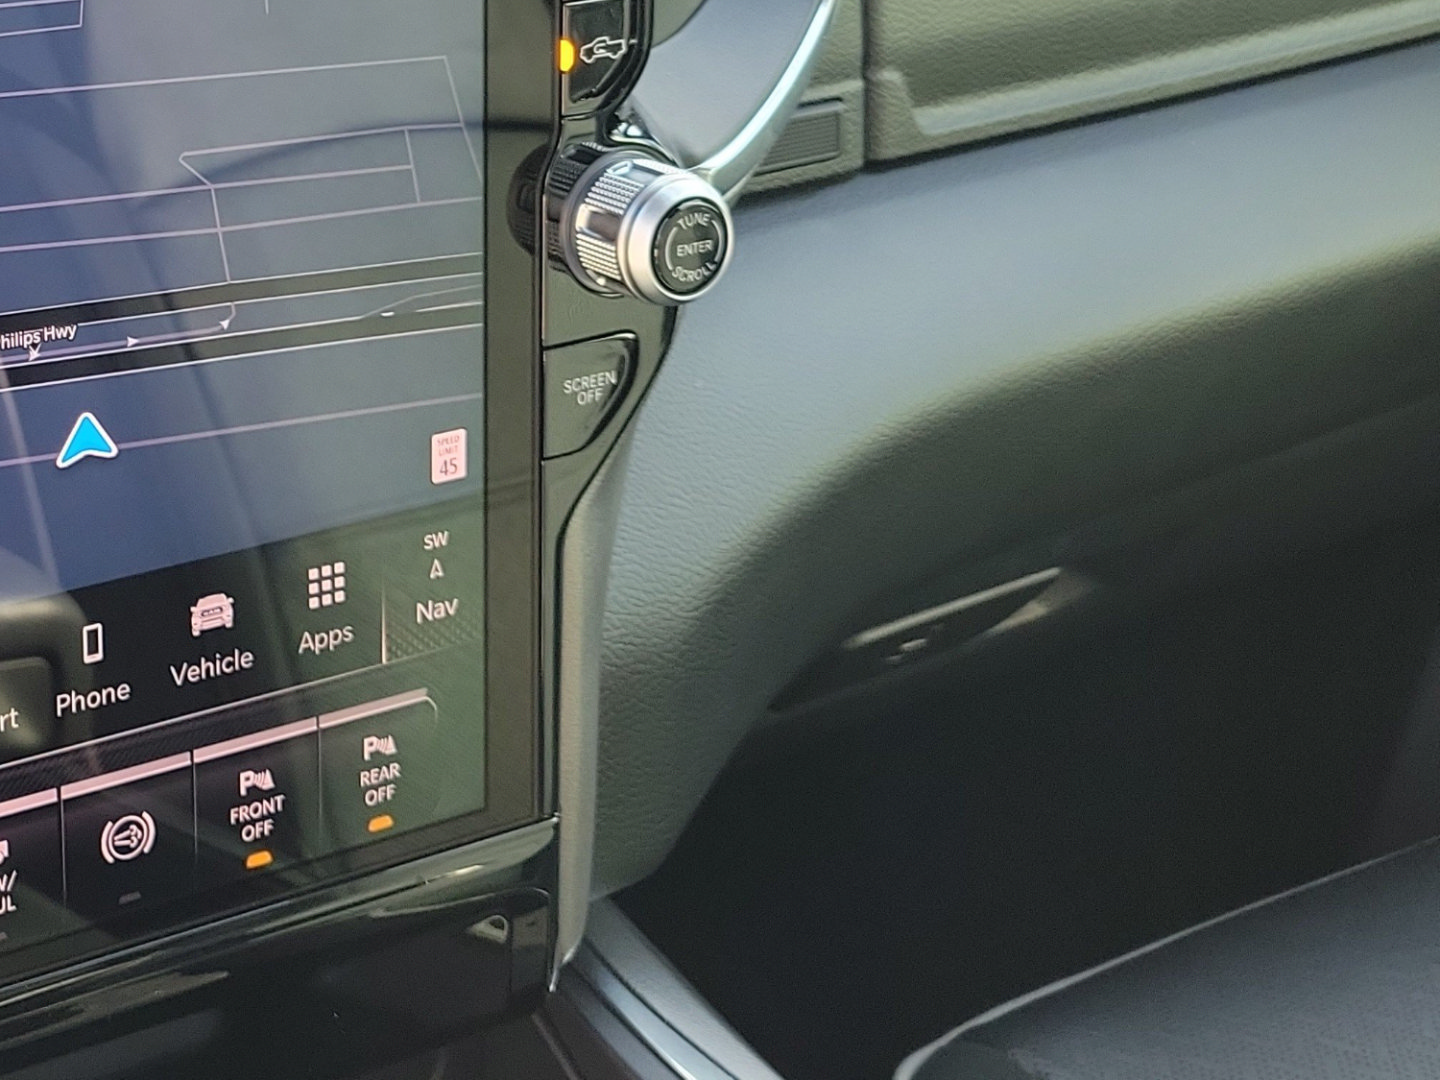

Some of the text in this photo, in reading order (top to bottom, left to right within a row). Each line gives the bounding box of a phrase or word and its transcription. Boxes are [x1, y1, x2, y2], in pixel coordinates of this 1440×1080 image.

[677, 211, 711, 231] TUNE
[676, 239, 714, 257] ENTER
[671, 261, 718, 282] SCROLL
[43, 323, 77, 341] Hwy
[563, 370, 618, 394] SCREEN
[577, 387, 604, 406] OFF
[439, 457, 458, 476] 45
[423, 530, 450, 551] SW
[416, 598, 459, 624] Nav
[298, 624, 355, 655] Apps
[169, 648, 255, 687] Vehicle
[55, 680, 132, 717] Phone
[360, 762, 402, 788] REAR
[364, 783, 398, 807] OFF
[229, 794, 286, 825] FRONT
[241, 819, 275, 843] OFF
